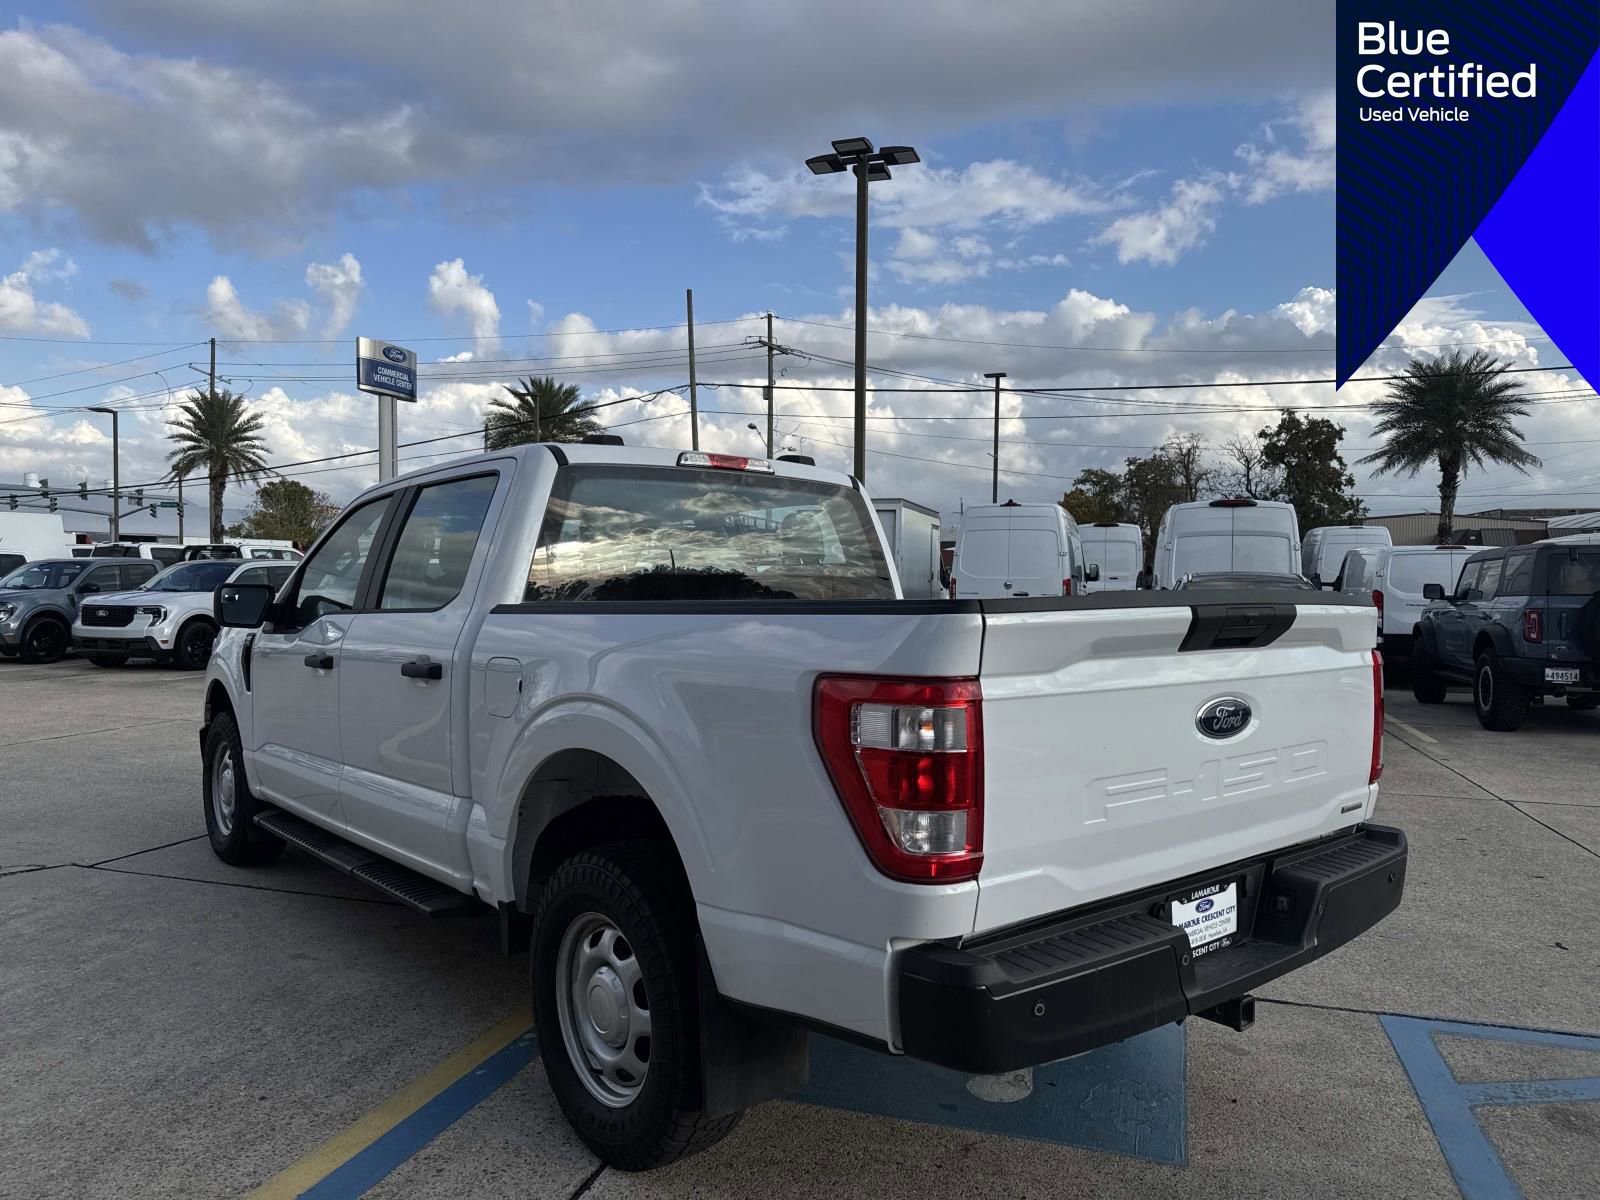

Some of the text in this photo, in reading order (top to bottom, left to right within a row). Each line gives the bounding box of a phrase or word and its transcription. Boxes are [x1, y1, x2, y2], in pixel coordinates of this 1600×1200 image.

[374, 373, 412, 390] VEHICLE CENTER
[377, 366, 409, 382] COMMERCIAL
[1213, 706, 1242, 731] Ford
[1083, 738, 1329, 825] F-150
[1191, 884, 1220, 900] LAMARQUE
[1201, 908, 1225, 923] CRESCENT
[1225, 905, 1236, 915] CITY
[1192, 944, 1209, 959] SCENT
[1209, 941, 1220, 952] CITY
